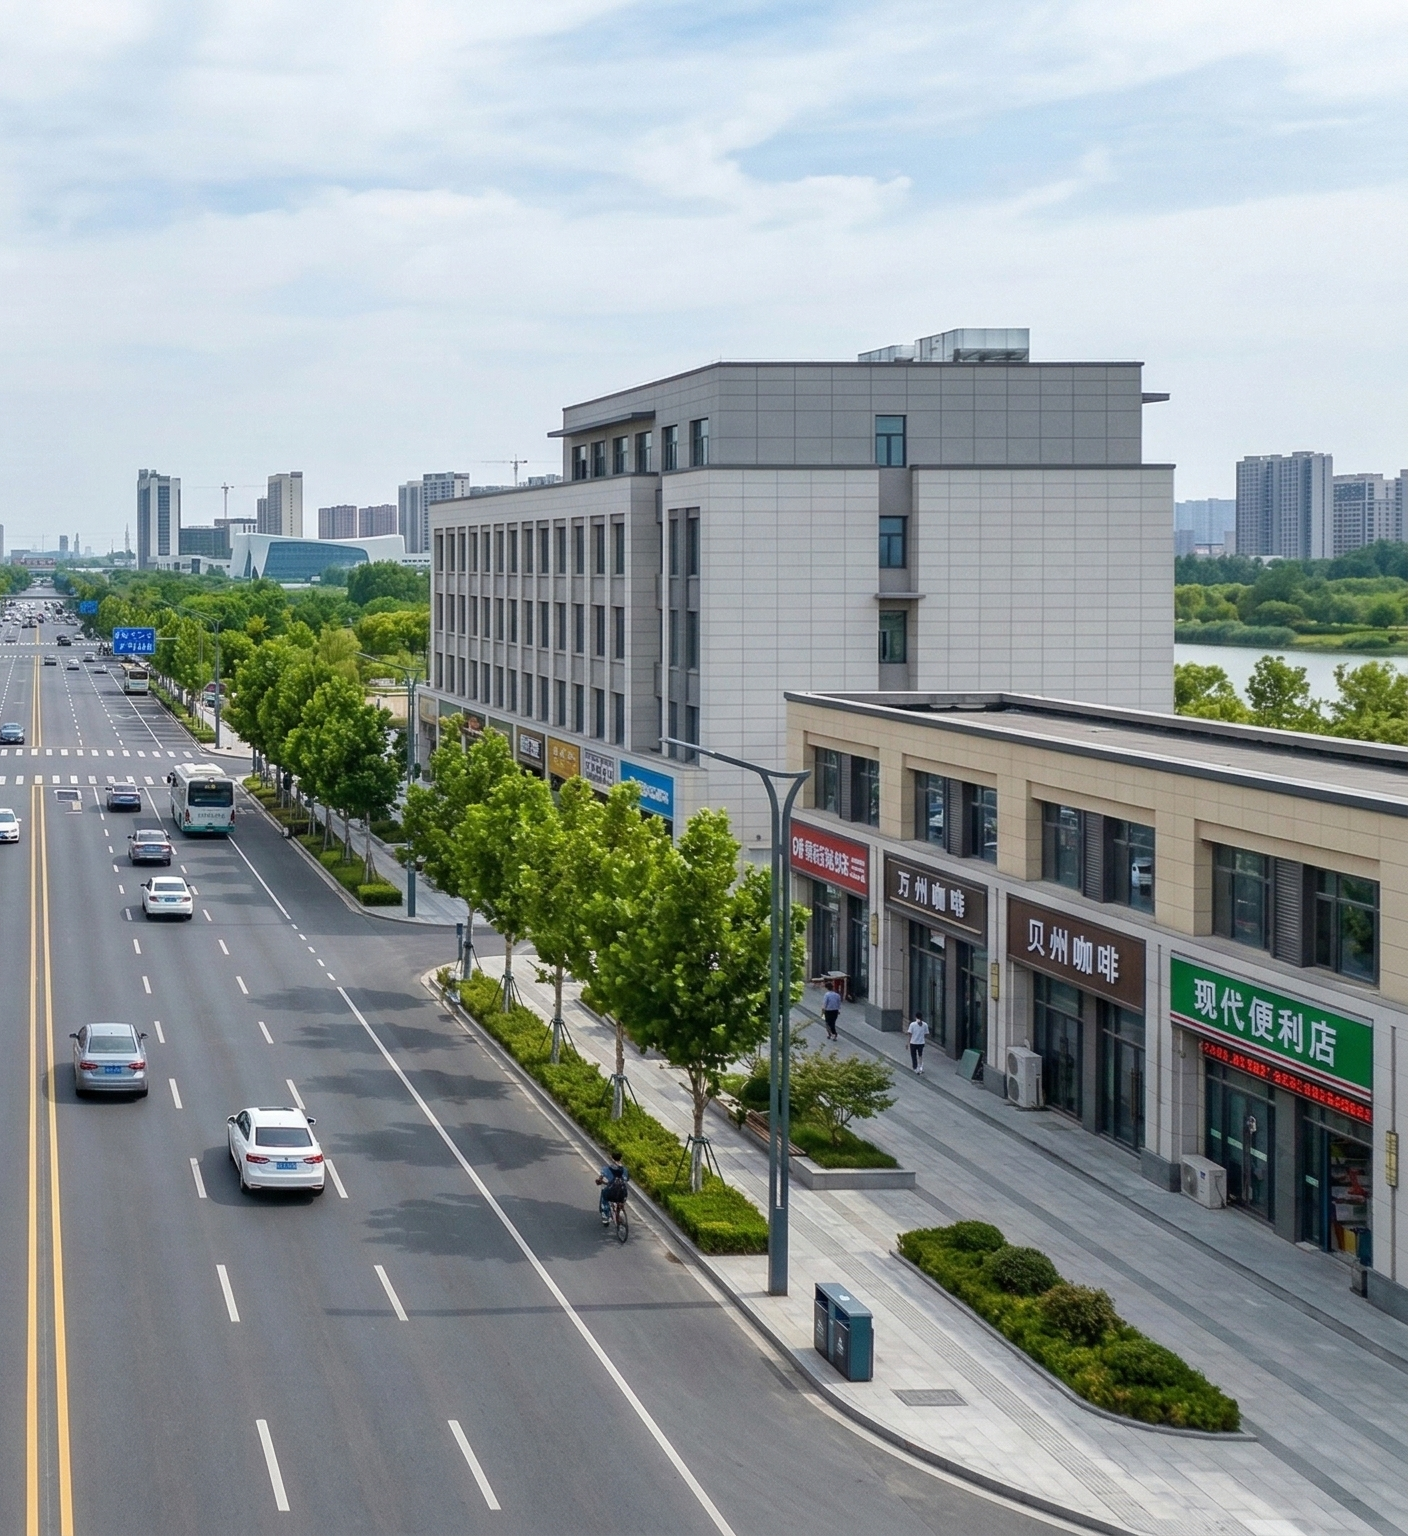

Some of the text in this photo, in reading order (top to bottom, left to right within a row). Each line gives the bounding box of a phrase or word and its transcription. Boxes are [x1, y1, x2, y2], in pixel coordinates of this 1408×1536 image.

[1027, 918, 1120, 984] 贝州咖啡
[1193, 977, 1338, 1068] 现代便利店
